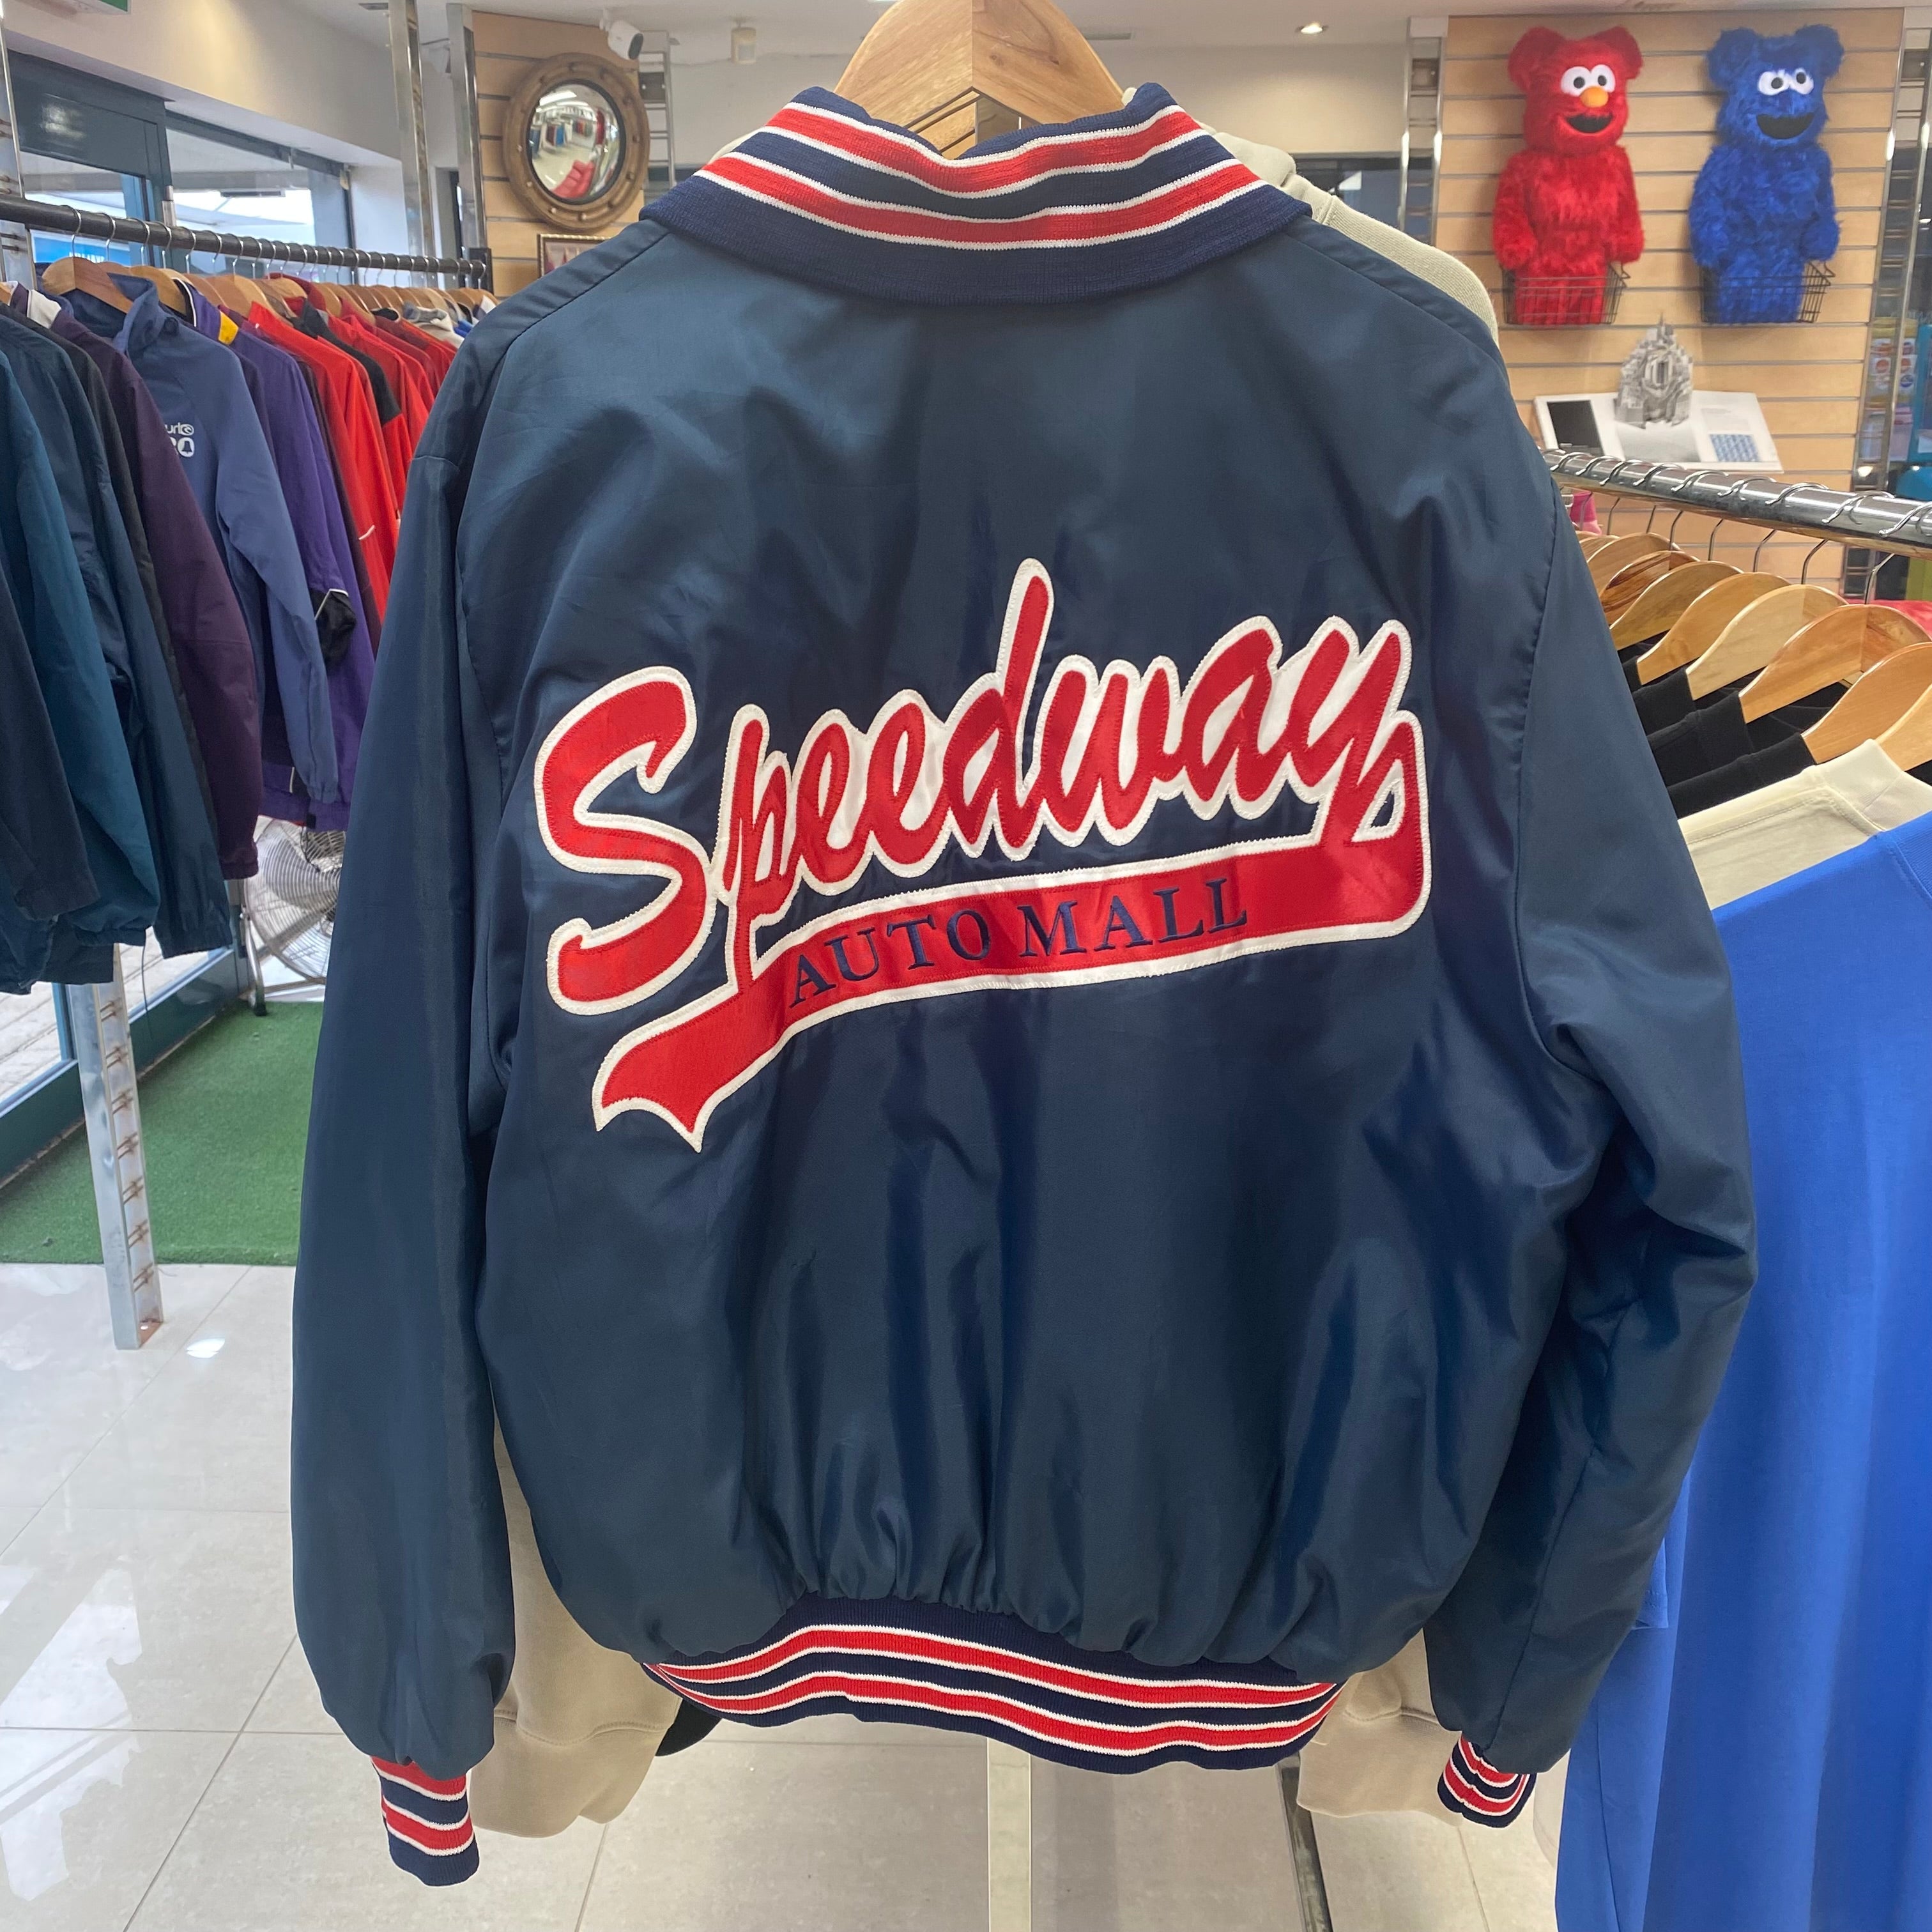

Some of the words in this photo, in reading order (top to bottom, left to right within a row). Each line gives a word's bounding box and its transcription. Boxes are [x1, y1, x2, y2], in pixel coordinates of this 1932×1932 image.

[535, 558, 1430, 1016] Speedway
[790, 908, 992, 1009] AUTO
[1018, 878, 1247, 958] MALL
